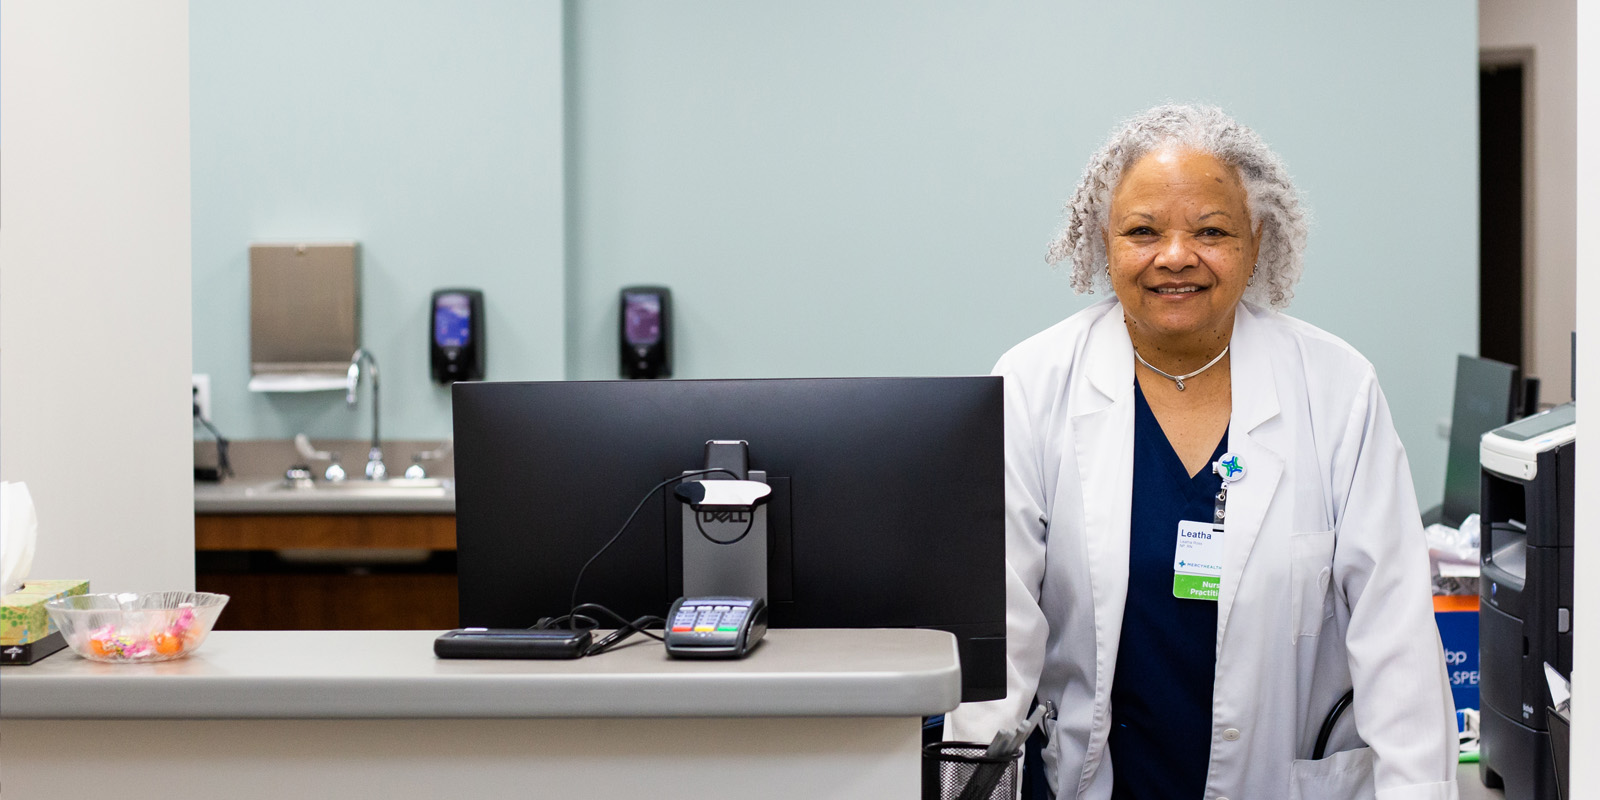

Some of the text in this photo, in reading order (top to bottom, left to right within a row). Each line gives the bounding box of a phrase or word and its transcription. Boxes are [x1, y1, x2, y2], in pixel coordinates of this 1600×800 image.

[703, 511, 748, 523] DELL
[1181, 529, 1212, 539] Leatha
[1449, 670, 1480, 685] -SPE
